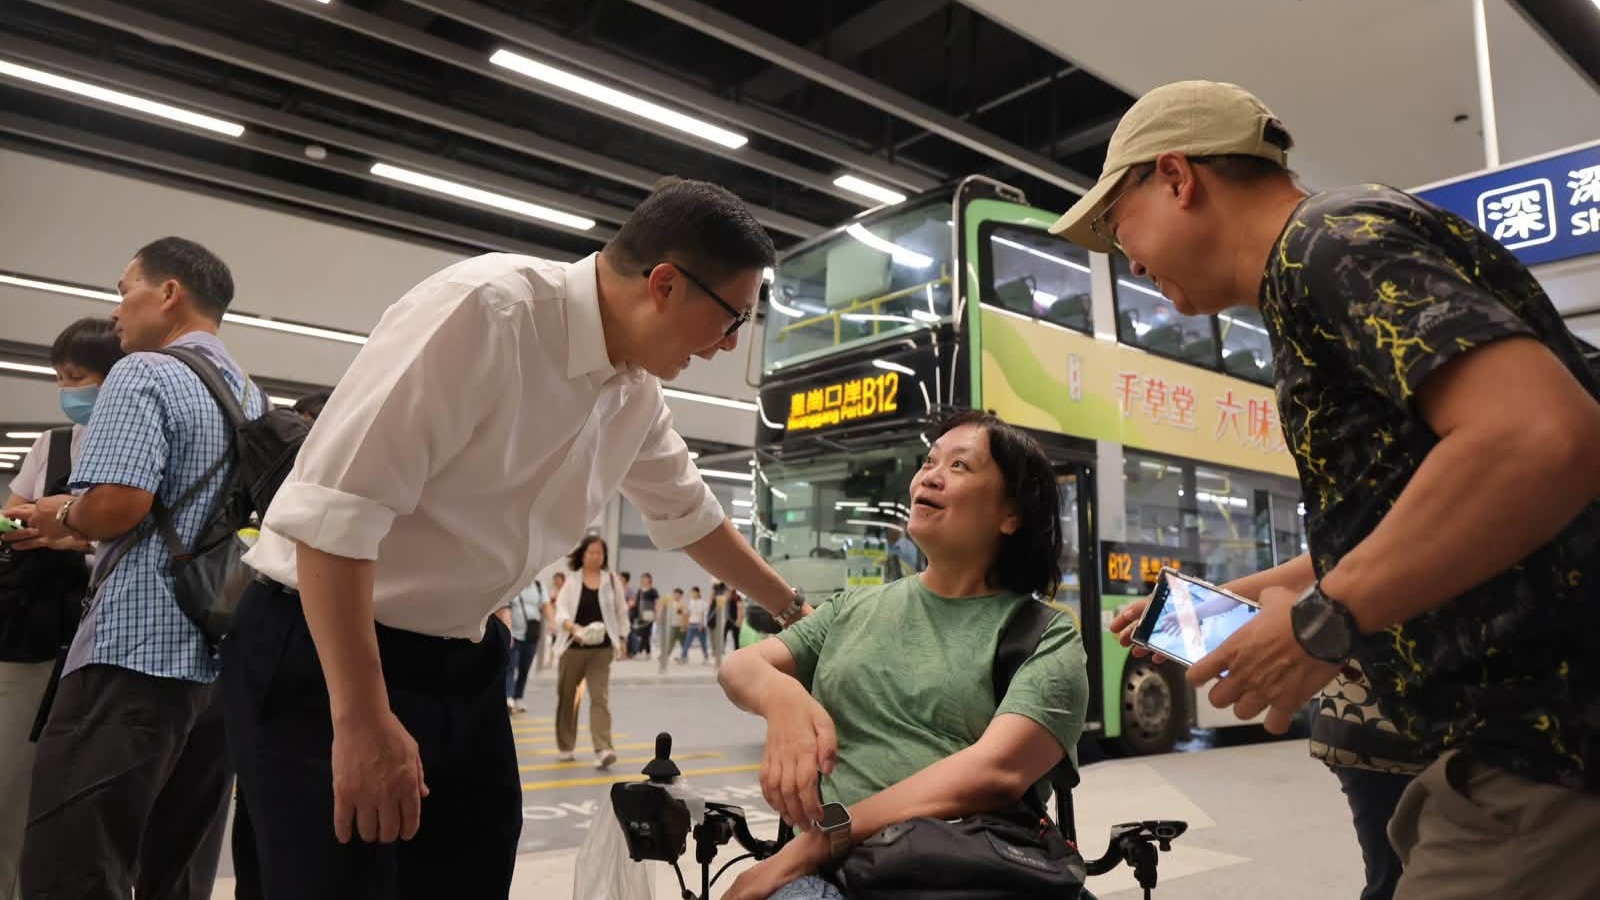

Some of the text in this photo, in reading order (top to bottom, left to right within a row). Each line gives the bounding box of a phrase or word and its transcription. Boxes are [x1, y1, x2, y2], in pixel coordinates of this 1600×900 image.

[1487, 190, 1546, 240] 深
[862, 372, 898, 415] B12
[1115, 371, 1198, 430] 千草堂
[1215, 388, 1287, 453] 六味
[1108, 552, 1133, 581] B12
